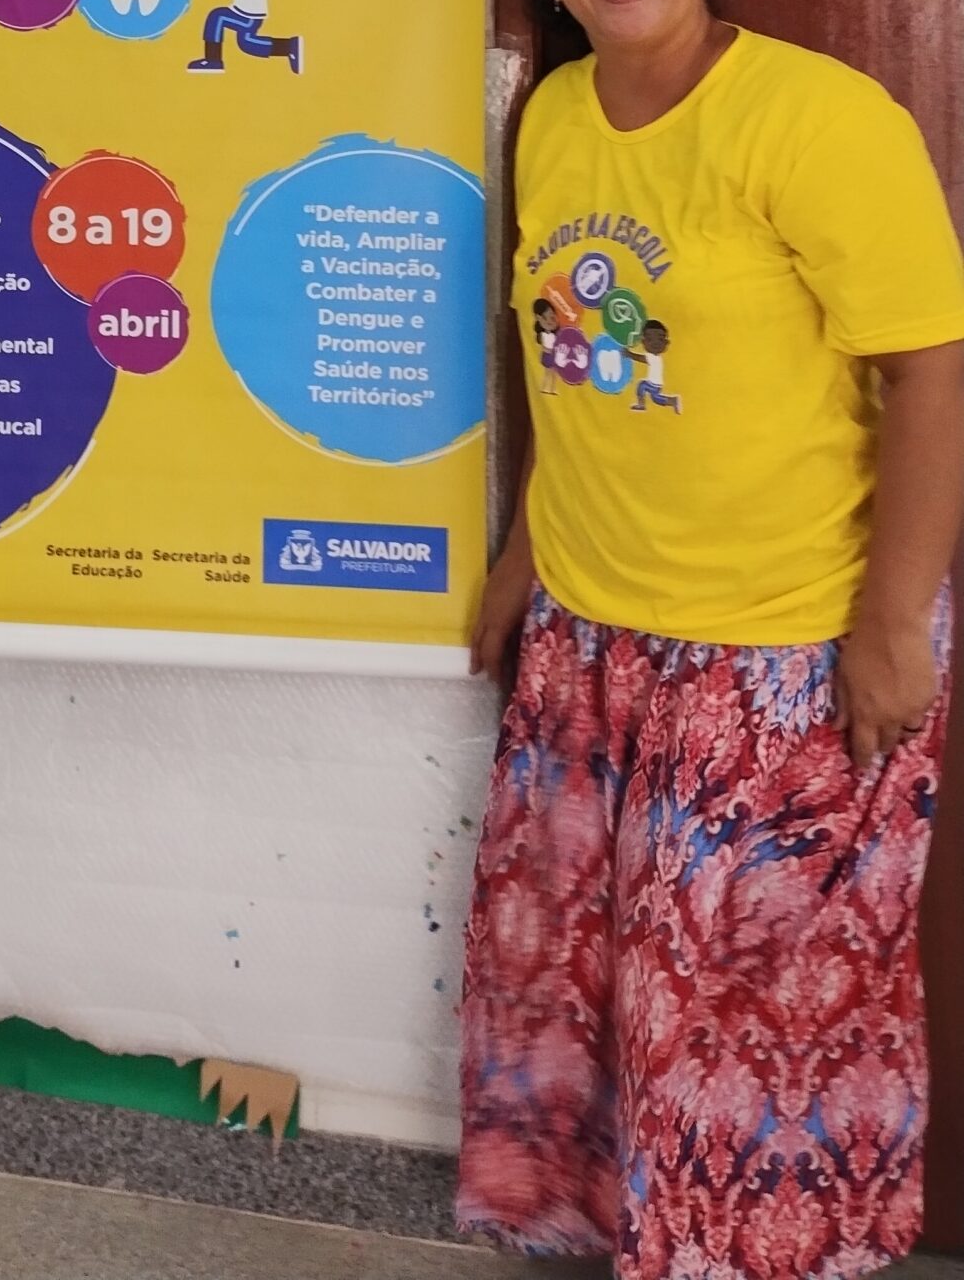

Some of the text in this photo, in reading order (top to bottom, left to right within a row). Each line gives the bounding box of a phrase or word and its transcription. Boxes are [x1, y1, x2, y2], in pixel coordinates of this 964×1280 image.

[303, 204, 439, 224] “Defender a
[47, 206, 173, 247] 8 a 19
[296, 230, 446, 253] vida, Ampliar
[301, 257, 441, 280] a Vacinação,
[306, 282, 436, 303] Combater a
[98, 308, 181, 339] abril
[318, 309, 424, 331] Dengue e
[317, 334, 426, 355] Promover
[313, 360, 429, 381] Saúde nos
[307, 385, 435, 407] Territórios”
[46, 544, 143, 560] Secretaria da
[152, 549, 251, 565] Secretaria da
[327, 538, 432, 562] SALVADOR
[71, 563, 143, 579] Educação
[205, 569, 251, 584] Saúde
[341, 560, 416, 574] PREFEITURA
